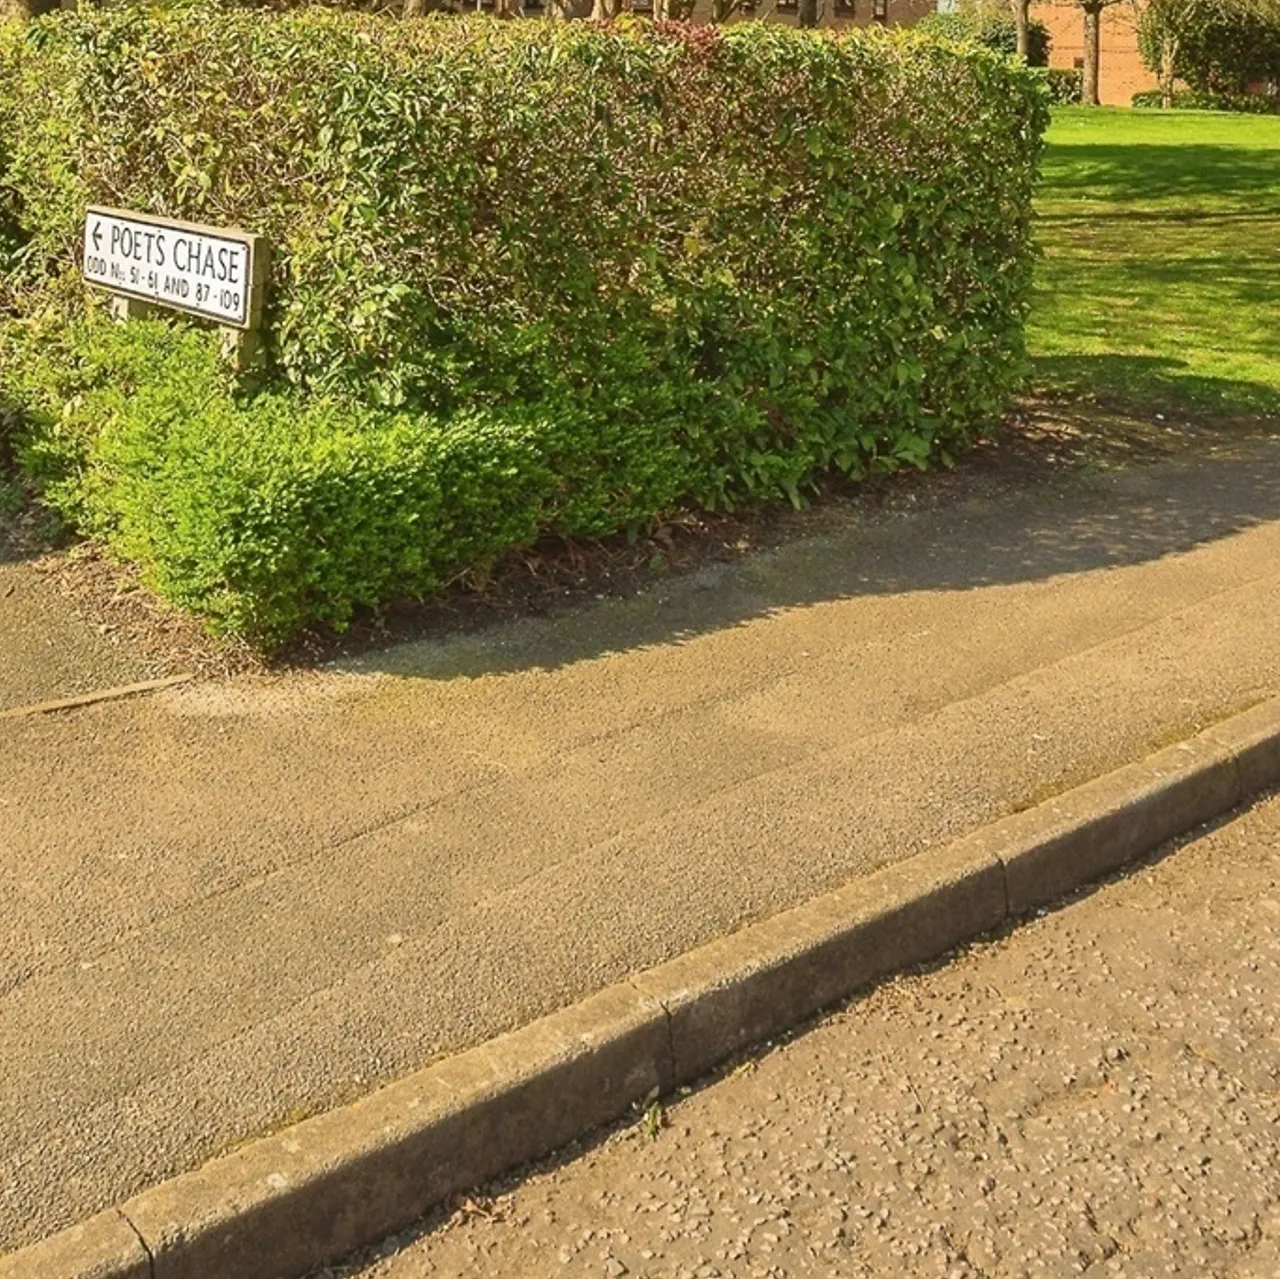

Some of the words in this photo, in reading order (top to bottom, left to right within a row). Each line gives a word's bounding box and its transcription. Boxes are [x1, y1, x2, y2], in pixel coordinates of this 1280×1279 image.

[87, 255, 107, 276] ODD
[164, 275, 189, 298] AND
[111, 225, 165, 266] POETS
[173, 238, 239, 283] CHASE
